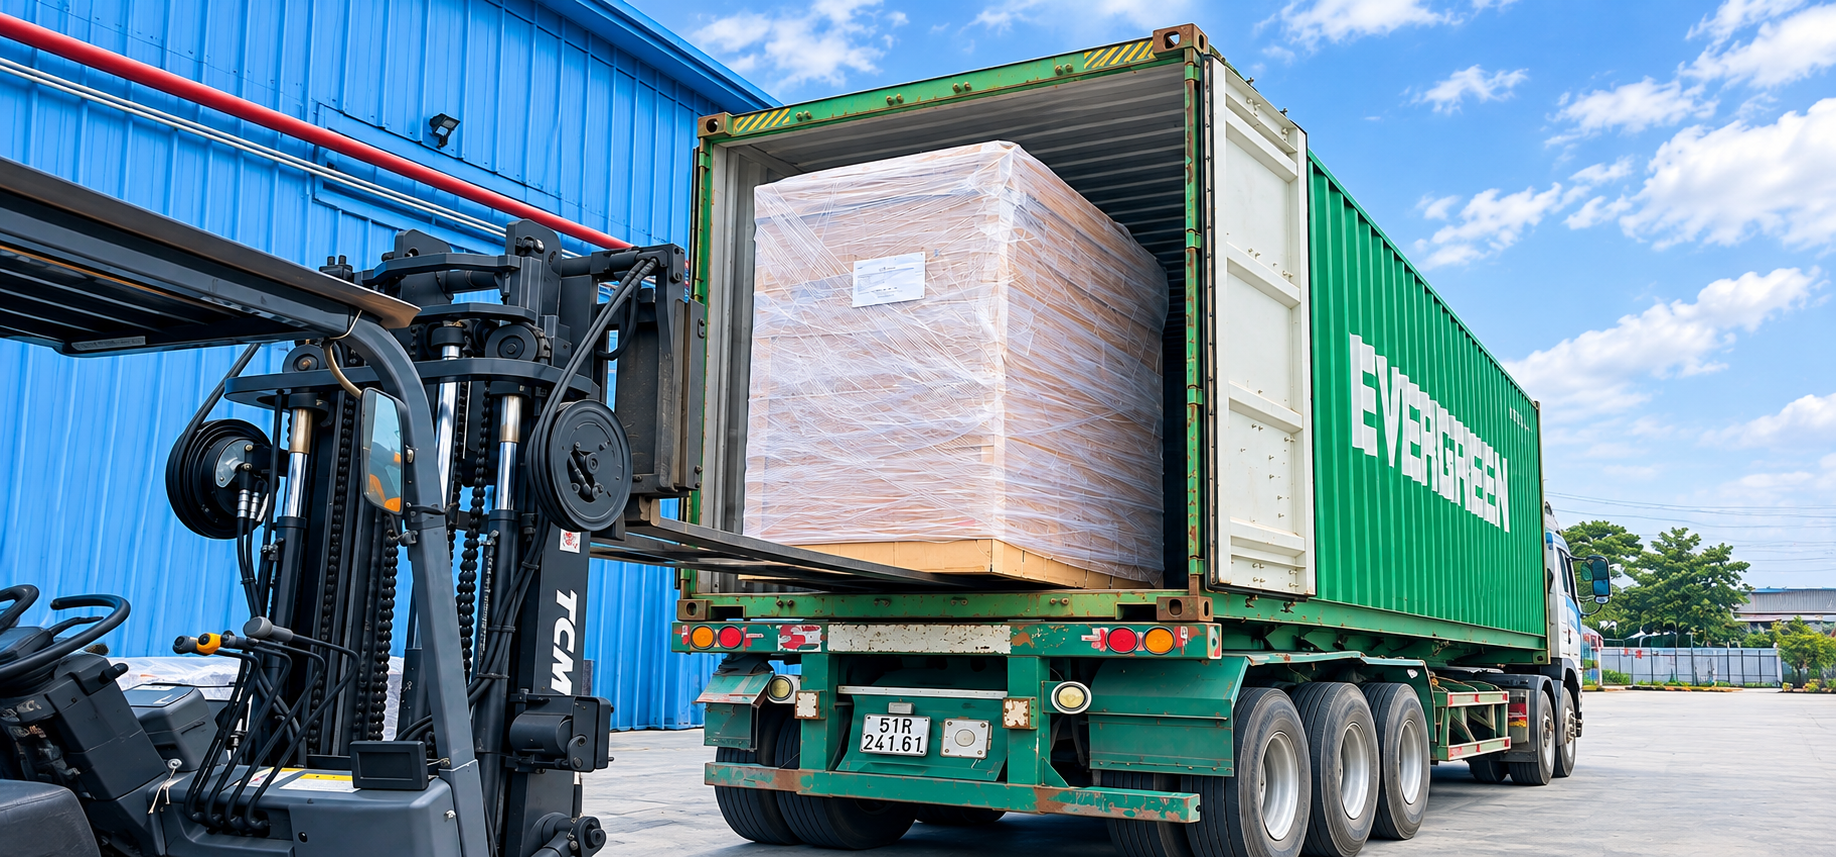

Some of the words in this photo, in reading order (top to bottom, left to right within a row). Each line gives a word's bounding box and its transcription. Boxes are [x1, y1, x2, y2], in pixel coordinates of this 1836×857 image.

[1349, 333, 1510, 533] EVERGREEN
[550, 589, 578, 696] TCM
[863, 734, 922, 753] 241.61
[879, 717, 913, 734] 51R
